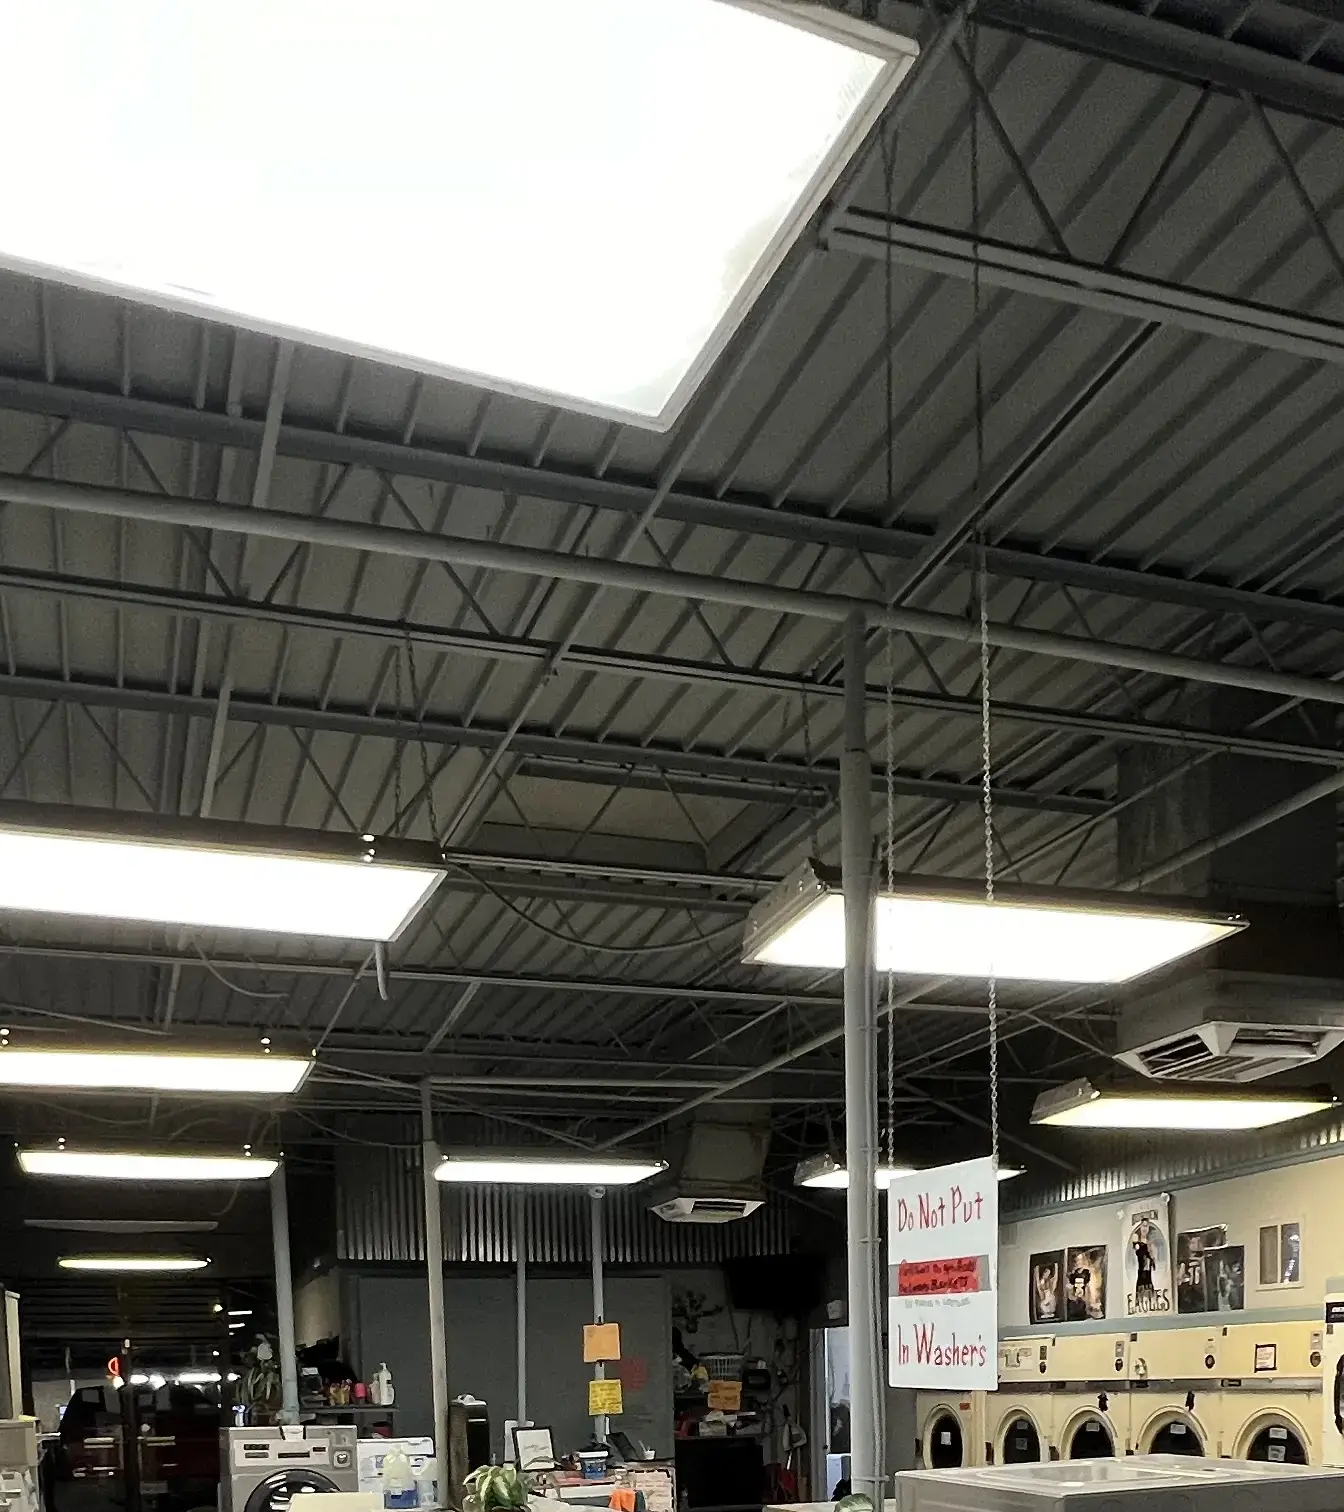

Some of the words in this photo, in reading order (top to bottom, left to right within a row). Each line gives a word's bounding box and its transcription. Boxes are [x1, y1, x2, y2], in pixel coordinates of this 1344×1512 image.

[897, 1198, 914, 1233] Do
[918, 1192, 945, 1229] Not
[950, 1185, 984, 1225] Put
[897, 1323, 910, 1366] In
[913, 1321, 987, 1367] Washer's
